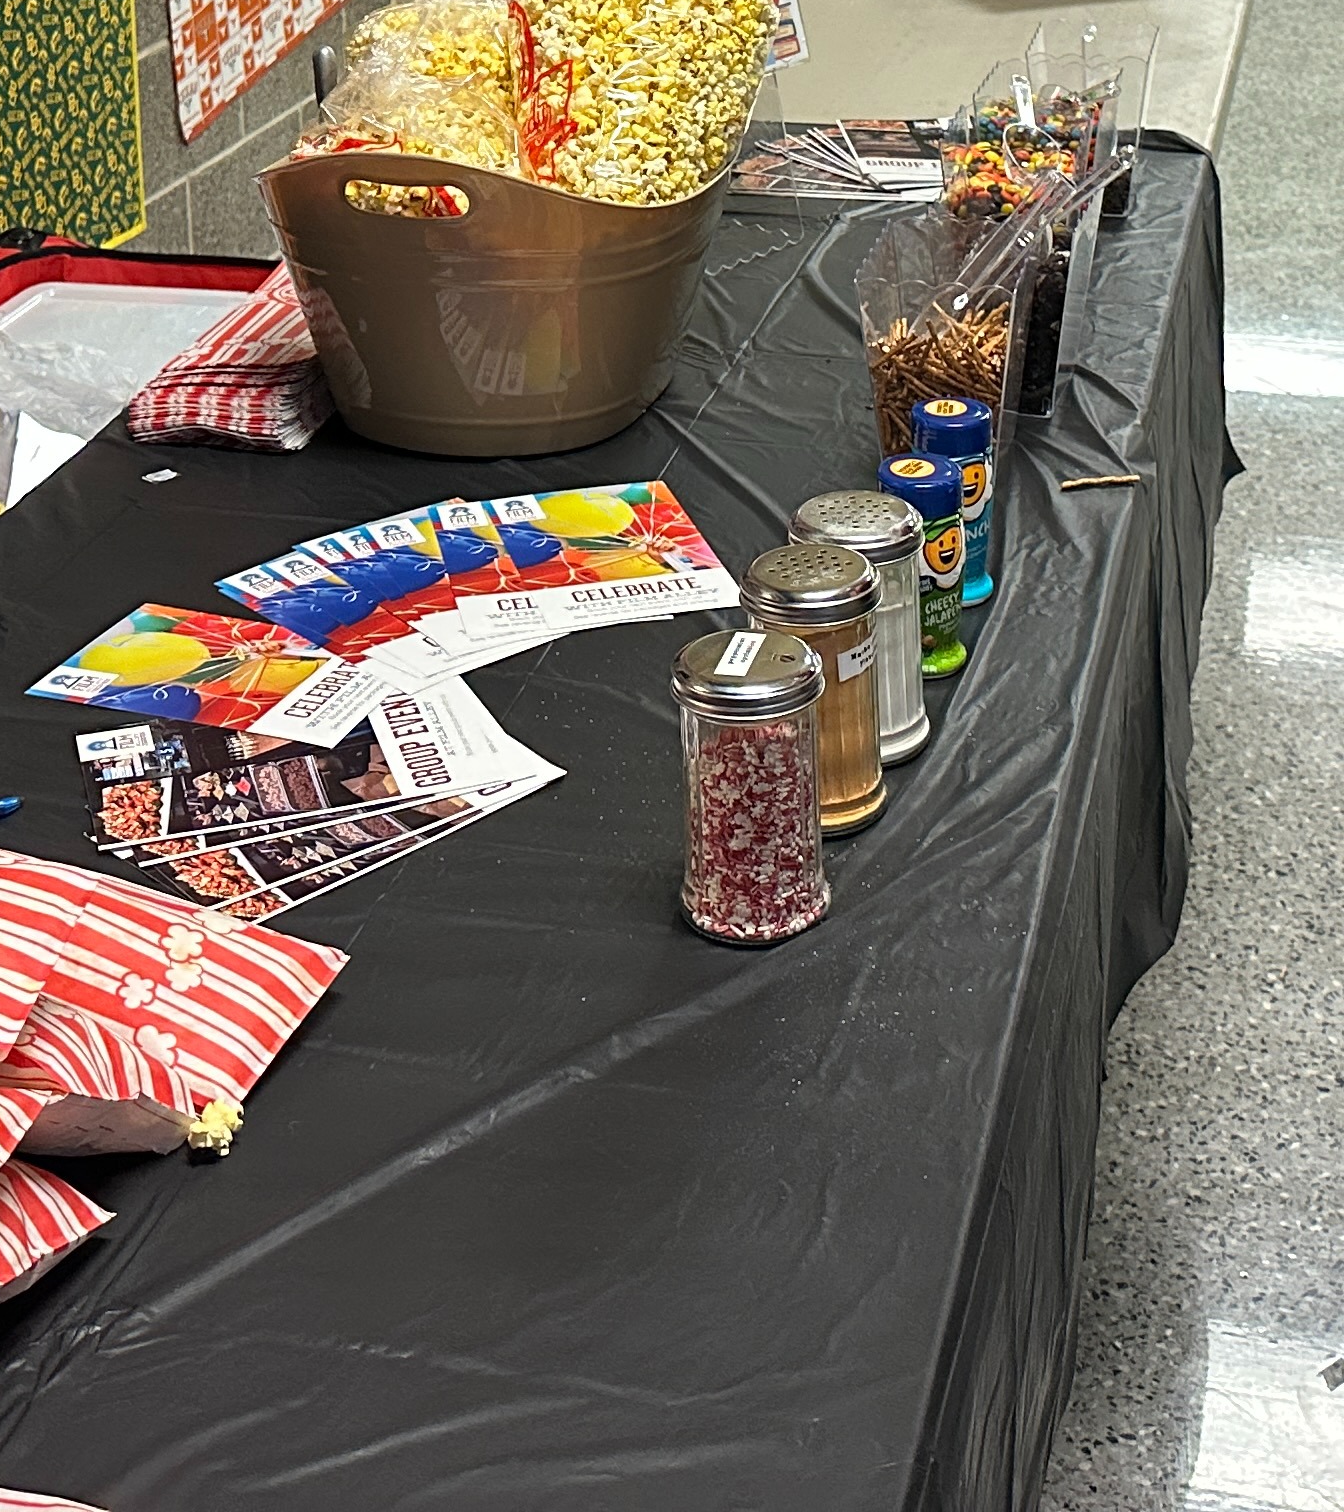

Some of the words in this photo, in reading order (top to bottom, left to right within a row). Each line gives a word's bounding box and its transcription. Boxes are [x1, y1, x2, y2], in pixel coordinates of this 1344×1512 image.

[965, 523, 991, 542] NCH
[571, 576, 702, 604] CELEBRATE
[924, 592, 960, 614] CHEESY
[283, 660, 360, 719] CELEBRAT
[399, 740, 453, 789] GROUP
